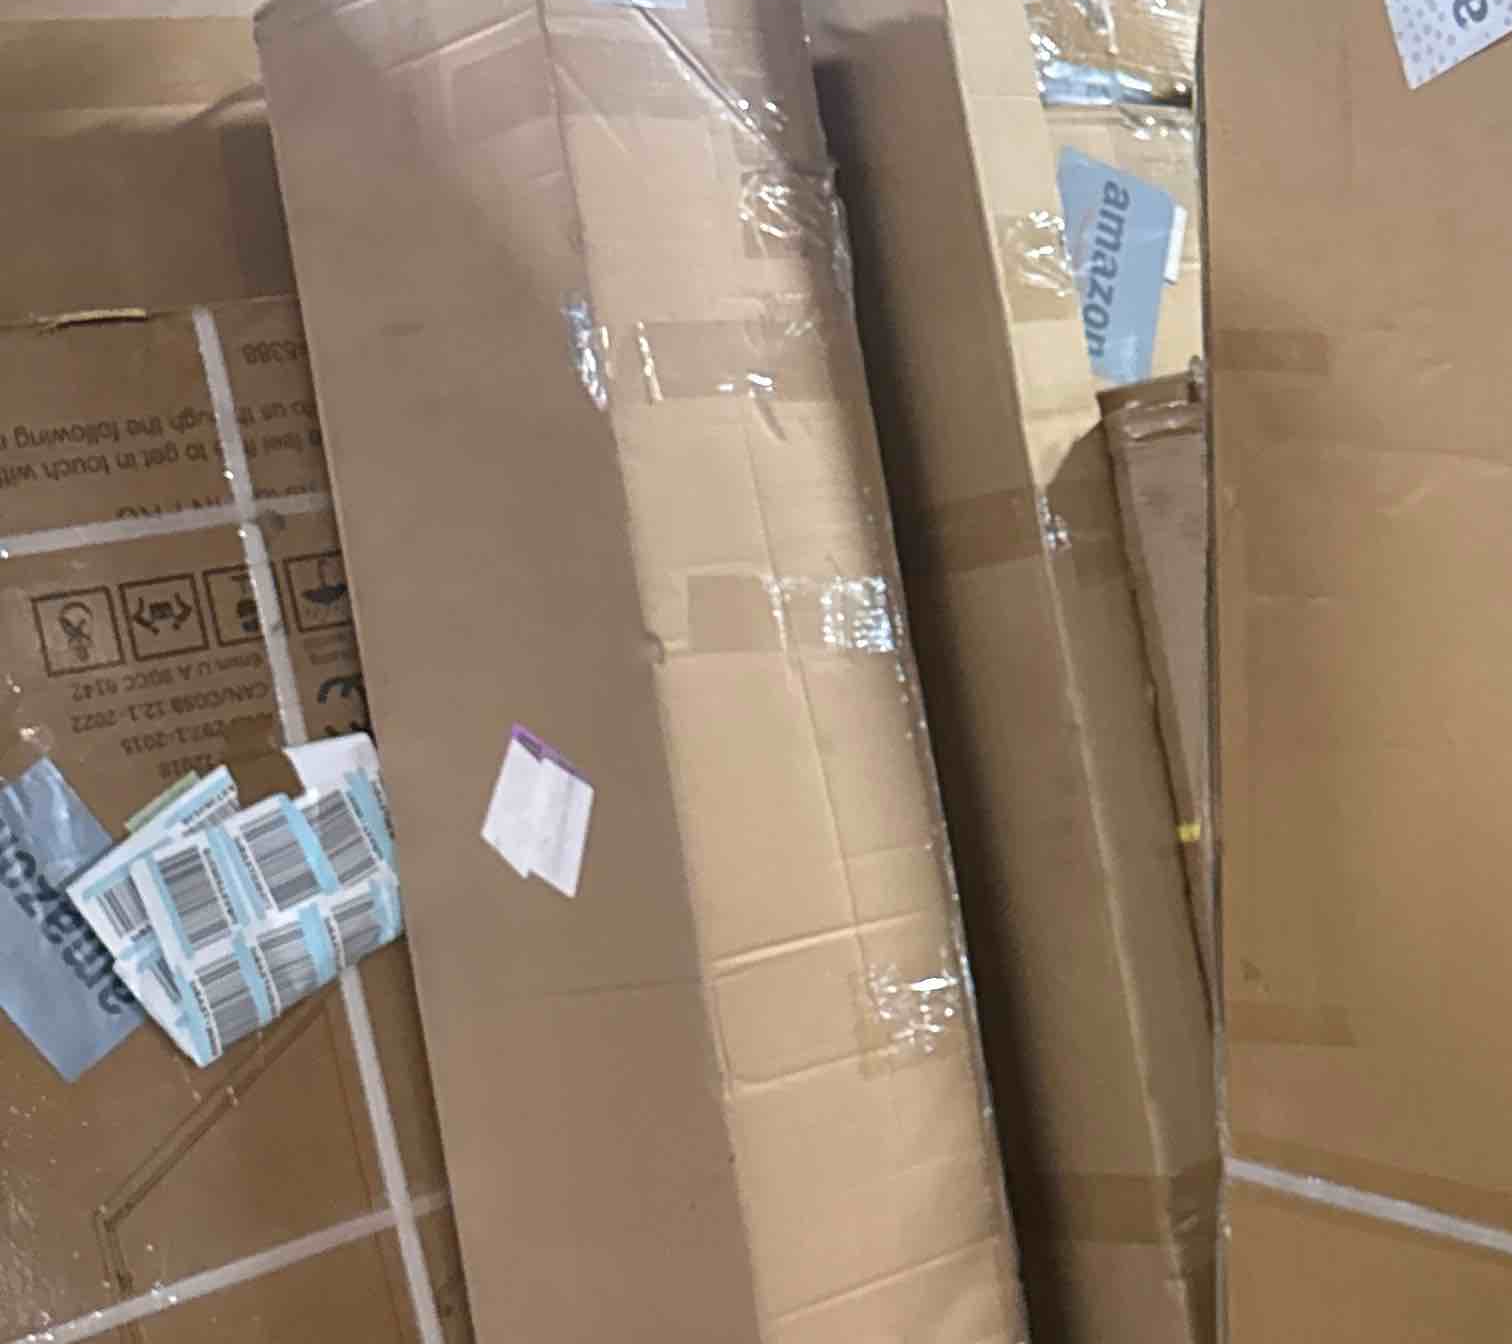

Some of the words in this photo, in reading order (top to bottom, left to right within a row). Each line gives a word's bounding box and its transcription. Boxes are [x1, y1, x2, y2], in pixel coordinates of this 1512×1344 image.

[1082, 180, 1131, 357] amazon
[12, 419, 119, 450] following
[115, 449, 139, 470] in
[142, 441, 179, 465] get
[185, 442, 208, 462] to
[44, 453, 111, 481] touch
[0, 814, 138, 1014] amazo
